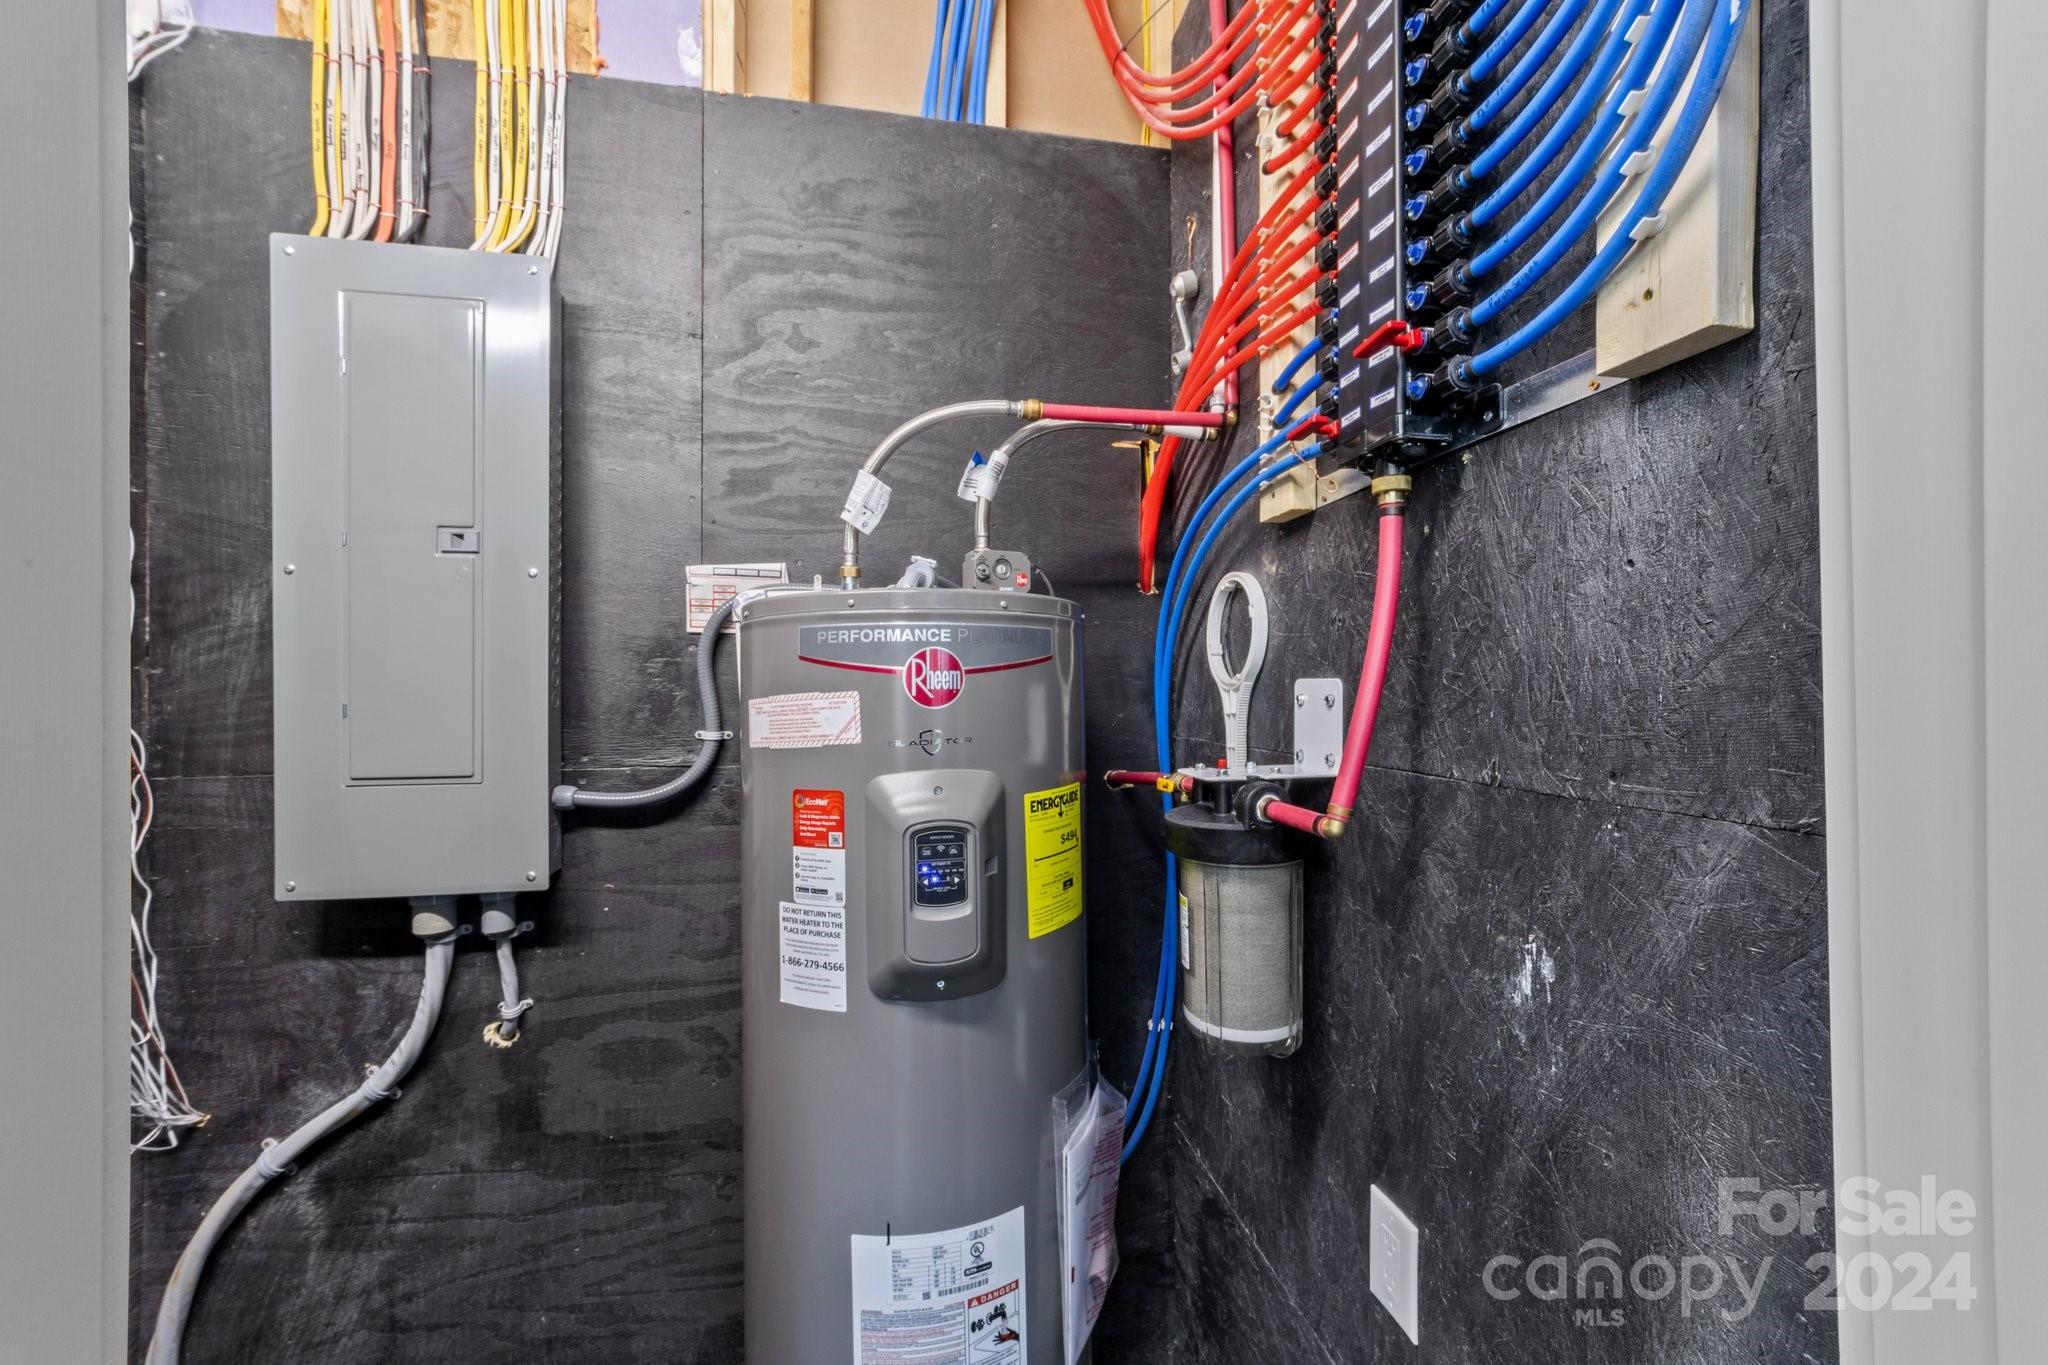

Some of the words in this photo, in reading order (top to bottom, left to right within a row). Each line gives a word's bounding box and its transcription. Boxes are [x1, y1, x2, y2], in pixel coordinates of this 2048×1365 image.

[817, 628, 951, 644] PERFORMANCE
[911, 649, 961, 699] Rheem
[791, 907, 802, 916] NOT
[804, 908, 826, 918] RETURN
[828, 911, 842, 919] THIS
[782, 916, 798, 925] WATER
[800, 918, 821, 927] HEATER
[822, 920, 830, 928] TO
[831, 920, 844, 929] THE
[784, 926, 800, 935] PLACE
[801, 928, 808, 936] OF
[809, 928, 841, 939] PURCHASE
[782, 954, 844, 972] 1-866-279-4566
[980, 1282, 1017, 1303] DANGER
